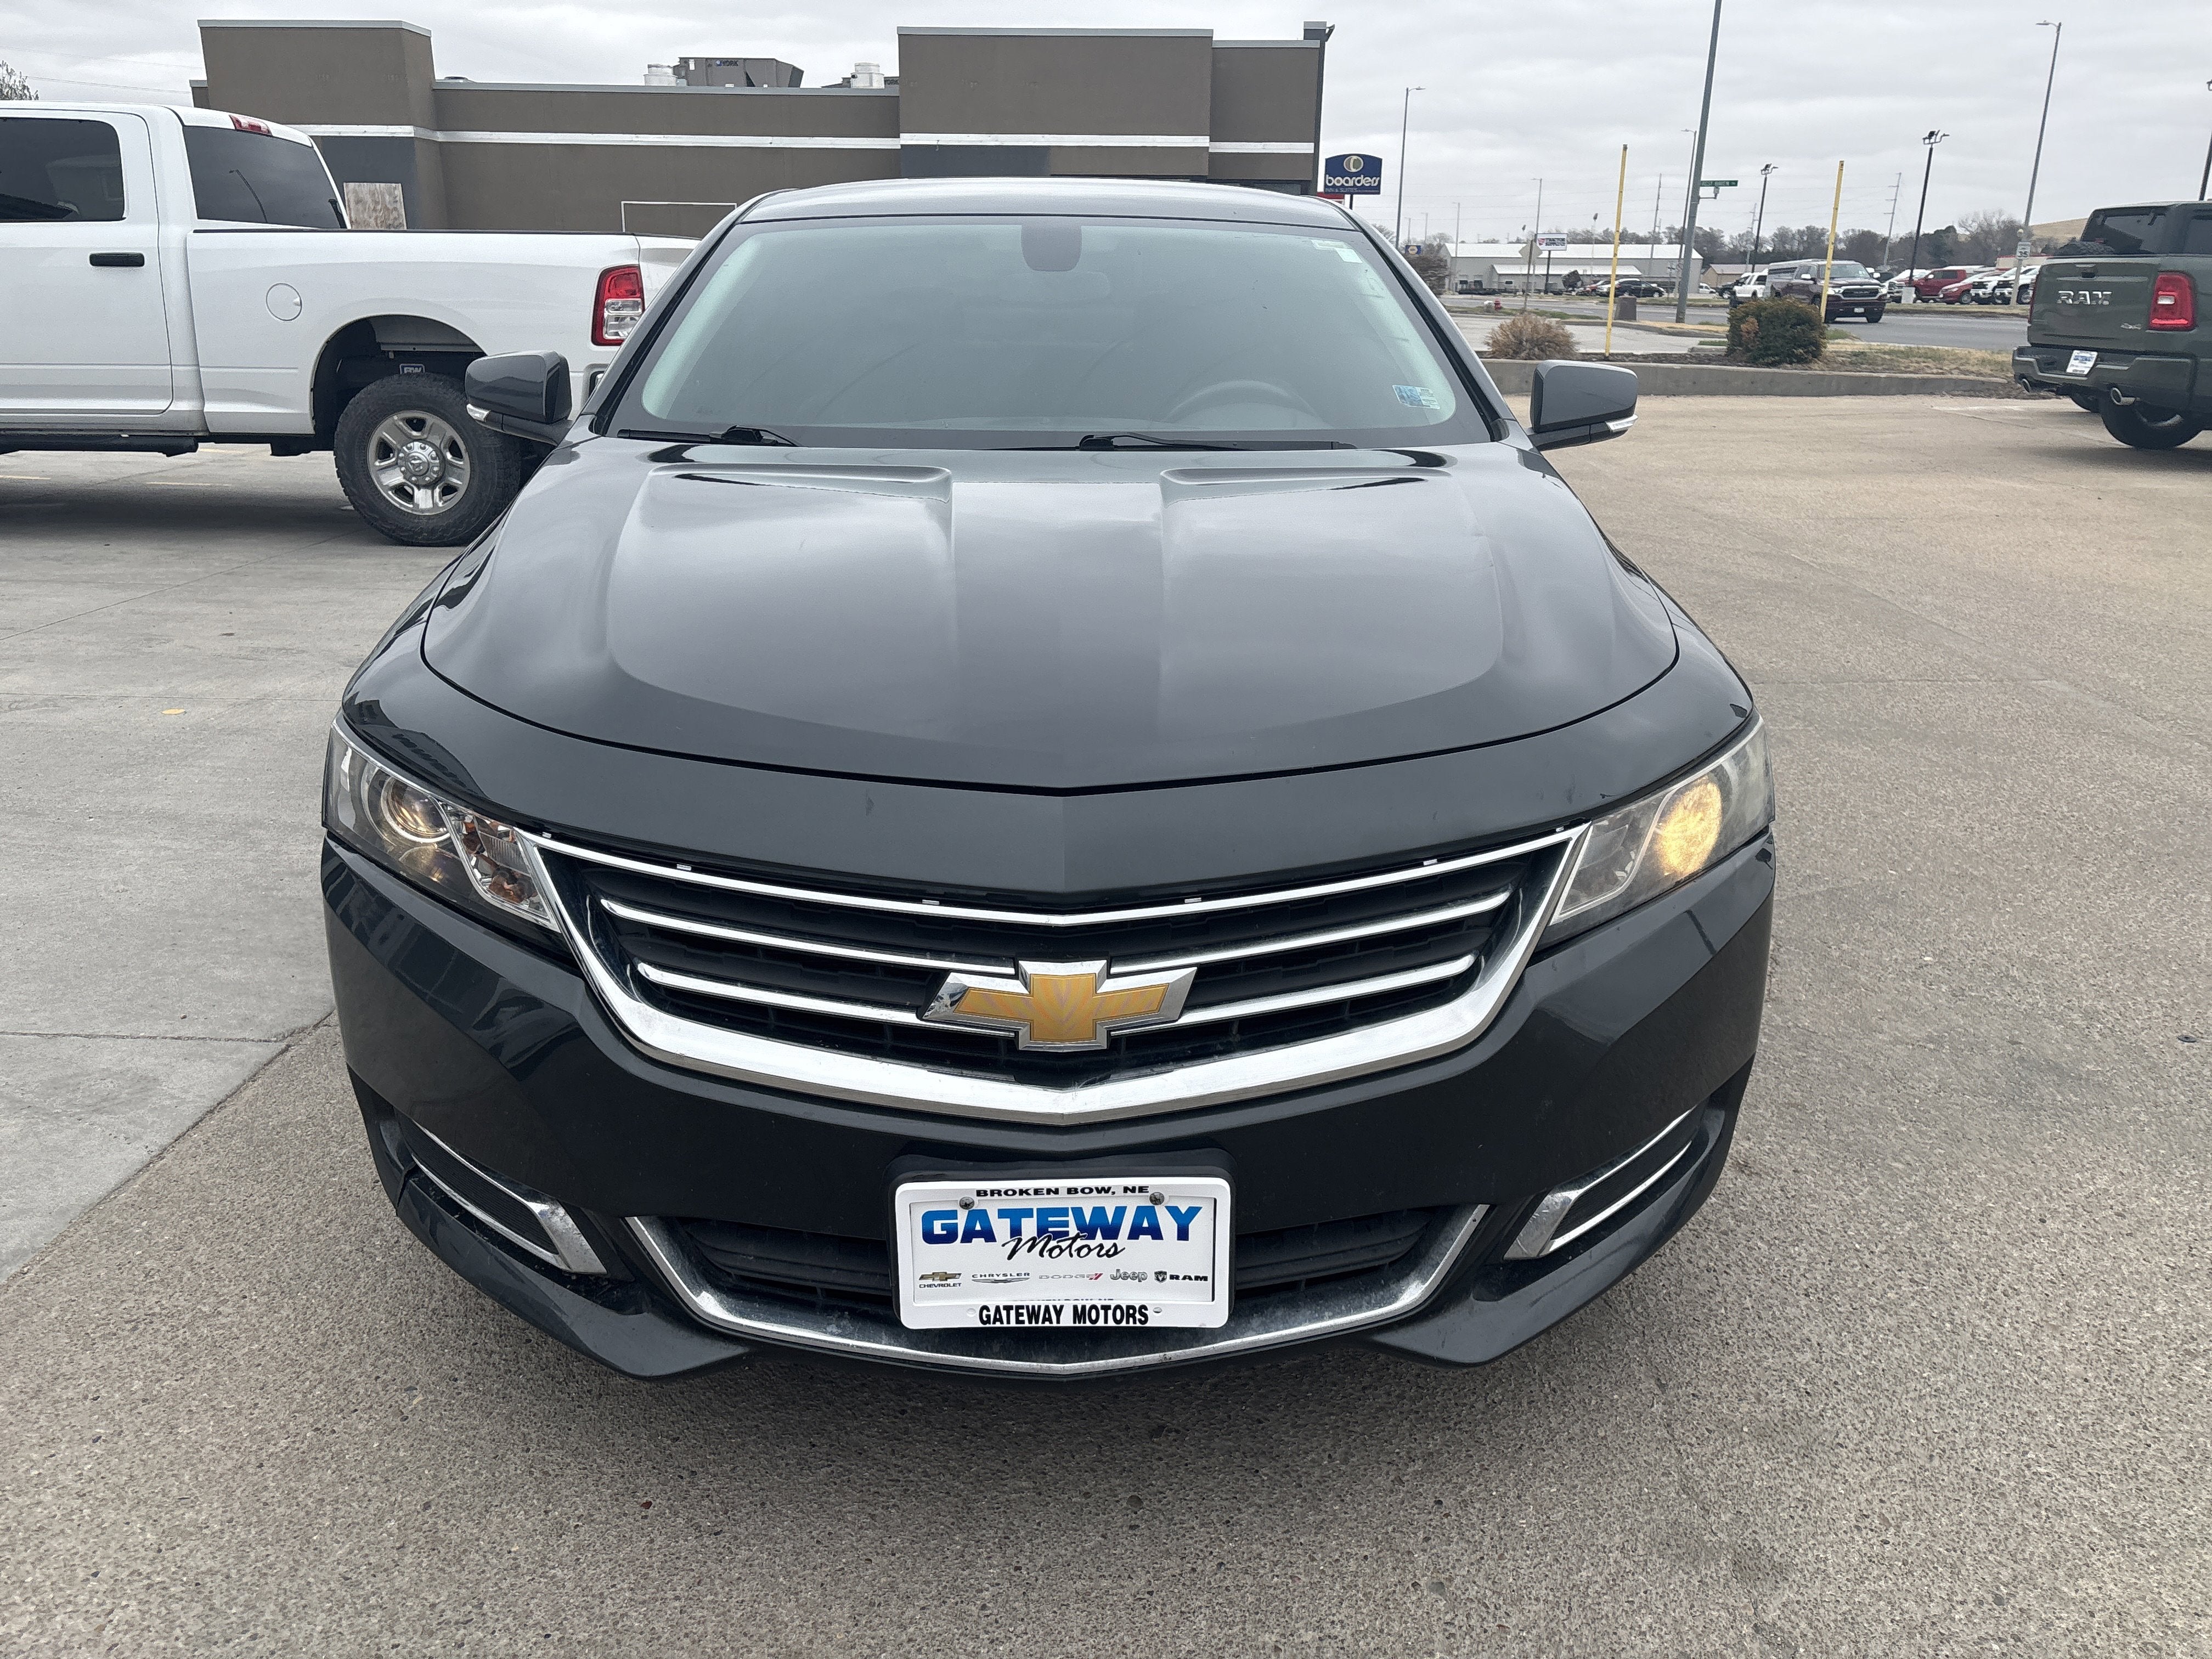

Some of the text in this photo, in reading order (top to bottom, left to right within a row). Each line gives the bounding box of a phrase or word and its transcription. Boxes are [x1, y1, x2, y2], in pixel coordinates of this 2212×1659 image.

[2057, 291, 2112, 305] RAM
[976, 1187, 1059, 1197] BROKEN
[1066, 1186, 1116, 1195] BOW,
[921, 1205, 1203, 1245] GATEWAY
[1001, 1232, 1126, 1261] Motors
[1109, 1268, 1148, 1283] Jeep
[979, 1304, 1149, 1325] GATEWAY MOTORS
